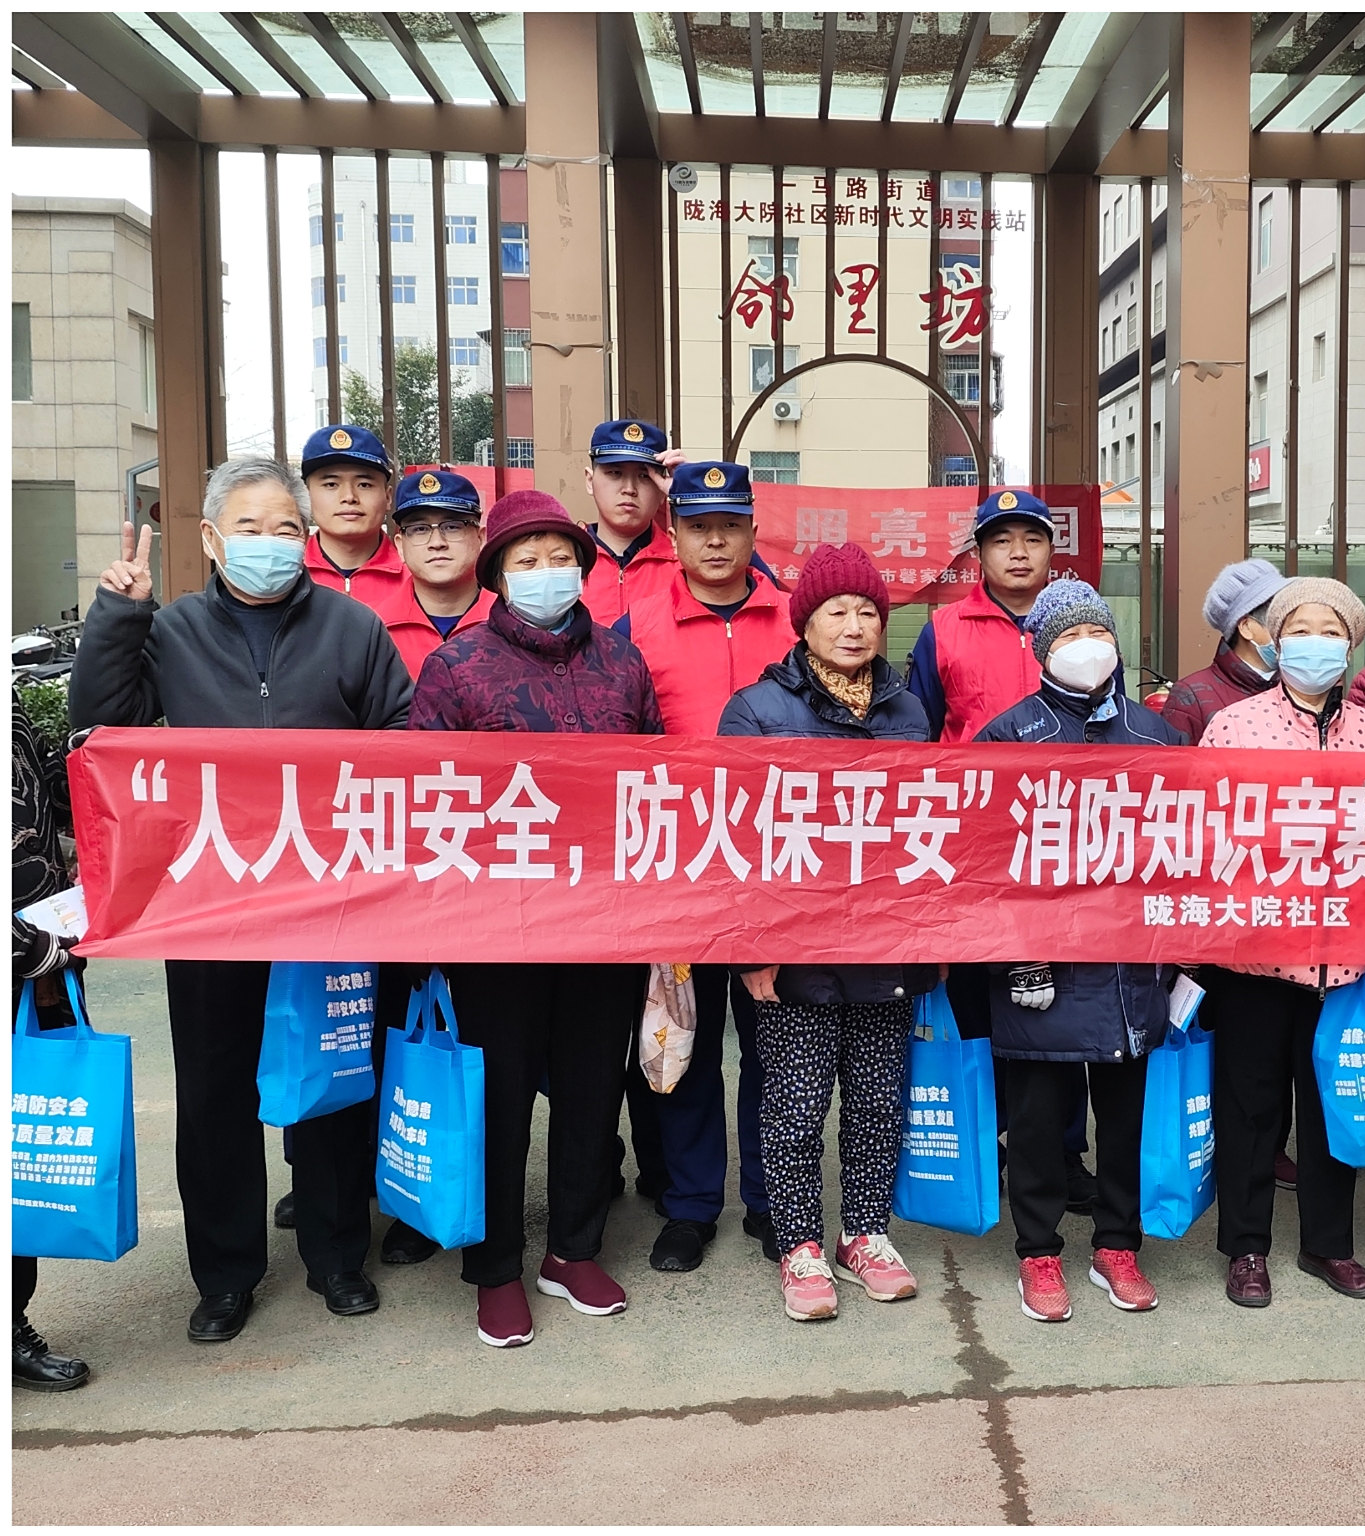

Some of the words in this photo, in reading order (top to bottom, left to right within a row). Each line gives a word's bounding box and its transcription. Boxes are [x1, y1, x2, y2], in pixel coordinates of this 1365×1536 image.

[780, 176, 935, 202] 一马路街道
[684, 199, 1027, 232] 陇海大院社区新时代文明实践站
[1143, 895, 1350, 929] 陇海大院社区
[12, 1093, 89, 1117] 消防安全
[12, 1123, 95, 1148] 质量发展
